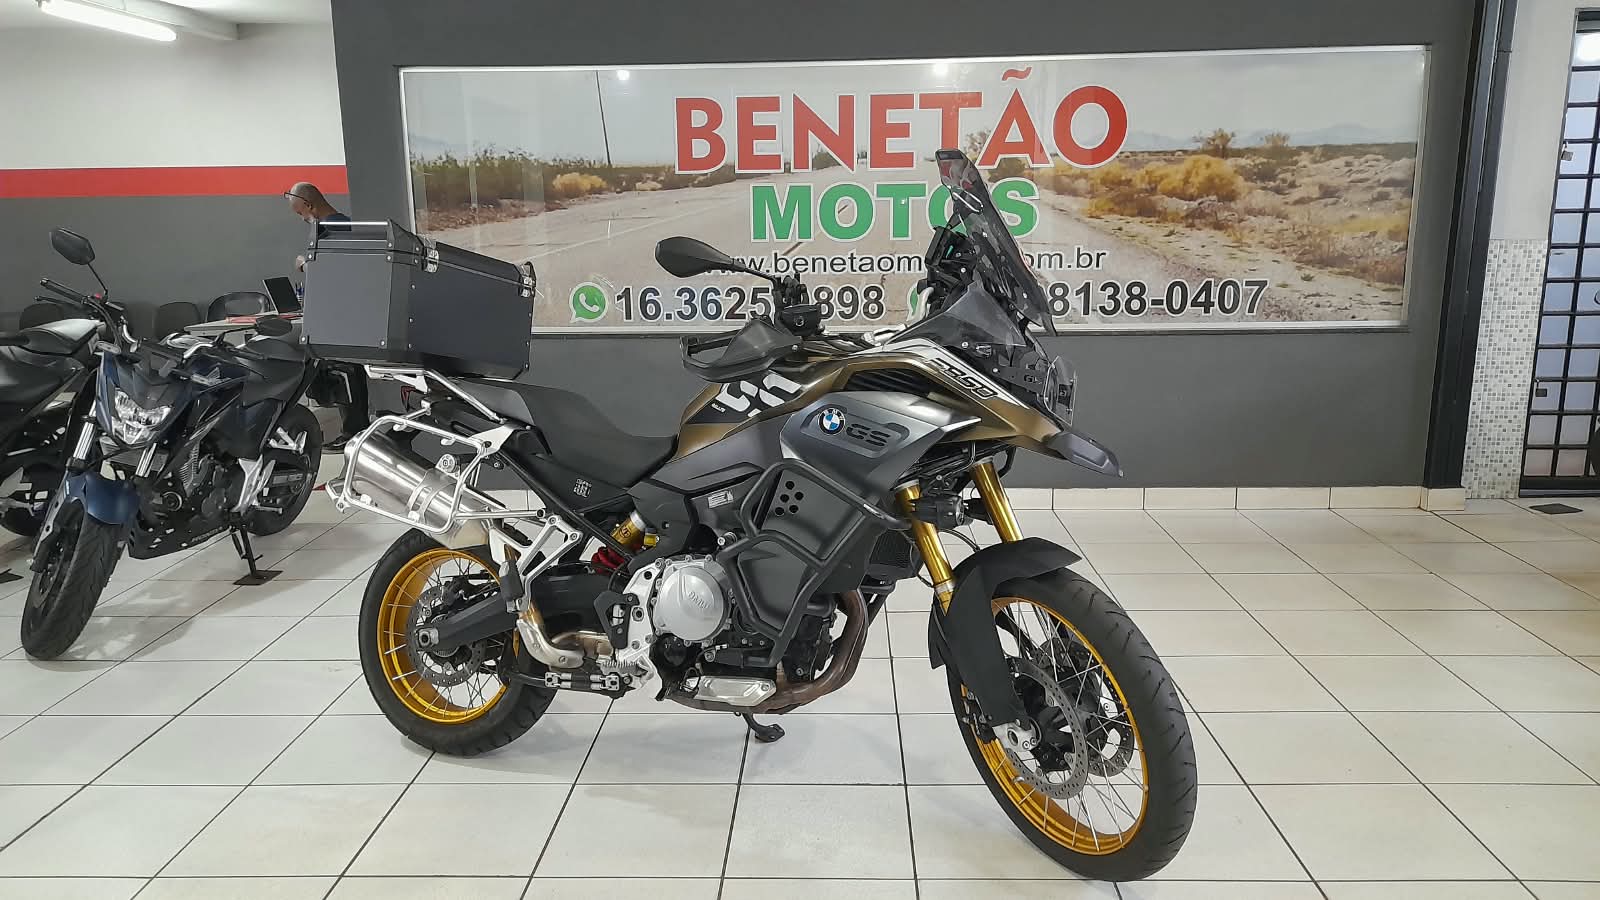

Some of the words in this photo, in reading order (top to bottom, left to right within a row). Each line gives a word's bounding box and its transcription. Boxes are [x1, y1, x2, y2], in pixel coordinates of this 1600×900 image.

[674, 65, 1129, 173] BENETÃO
[616, 286, 885, 321] 16.3625898
[845, 423, 891, 447] GS
